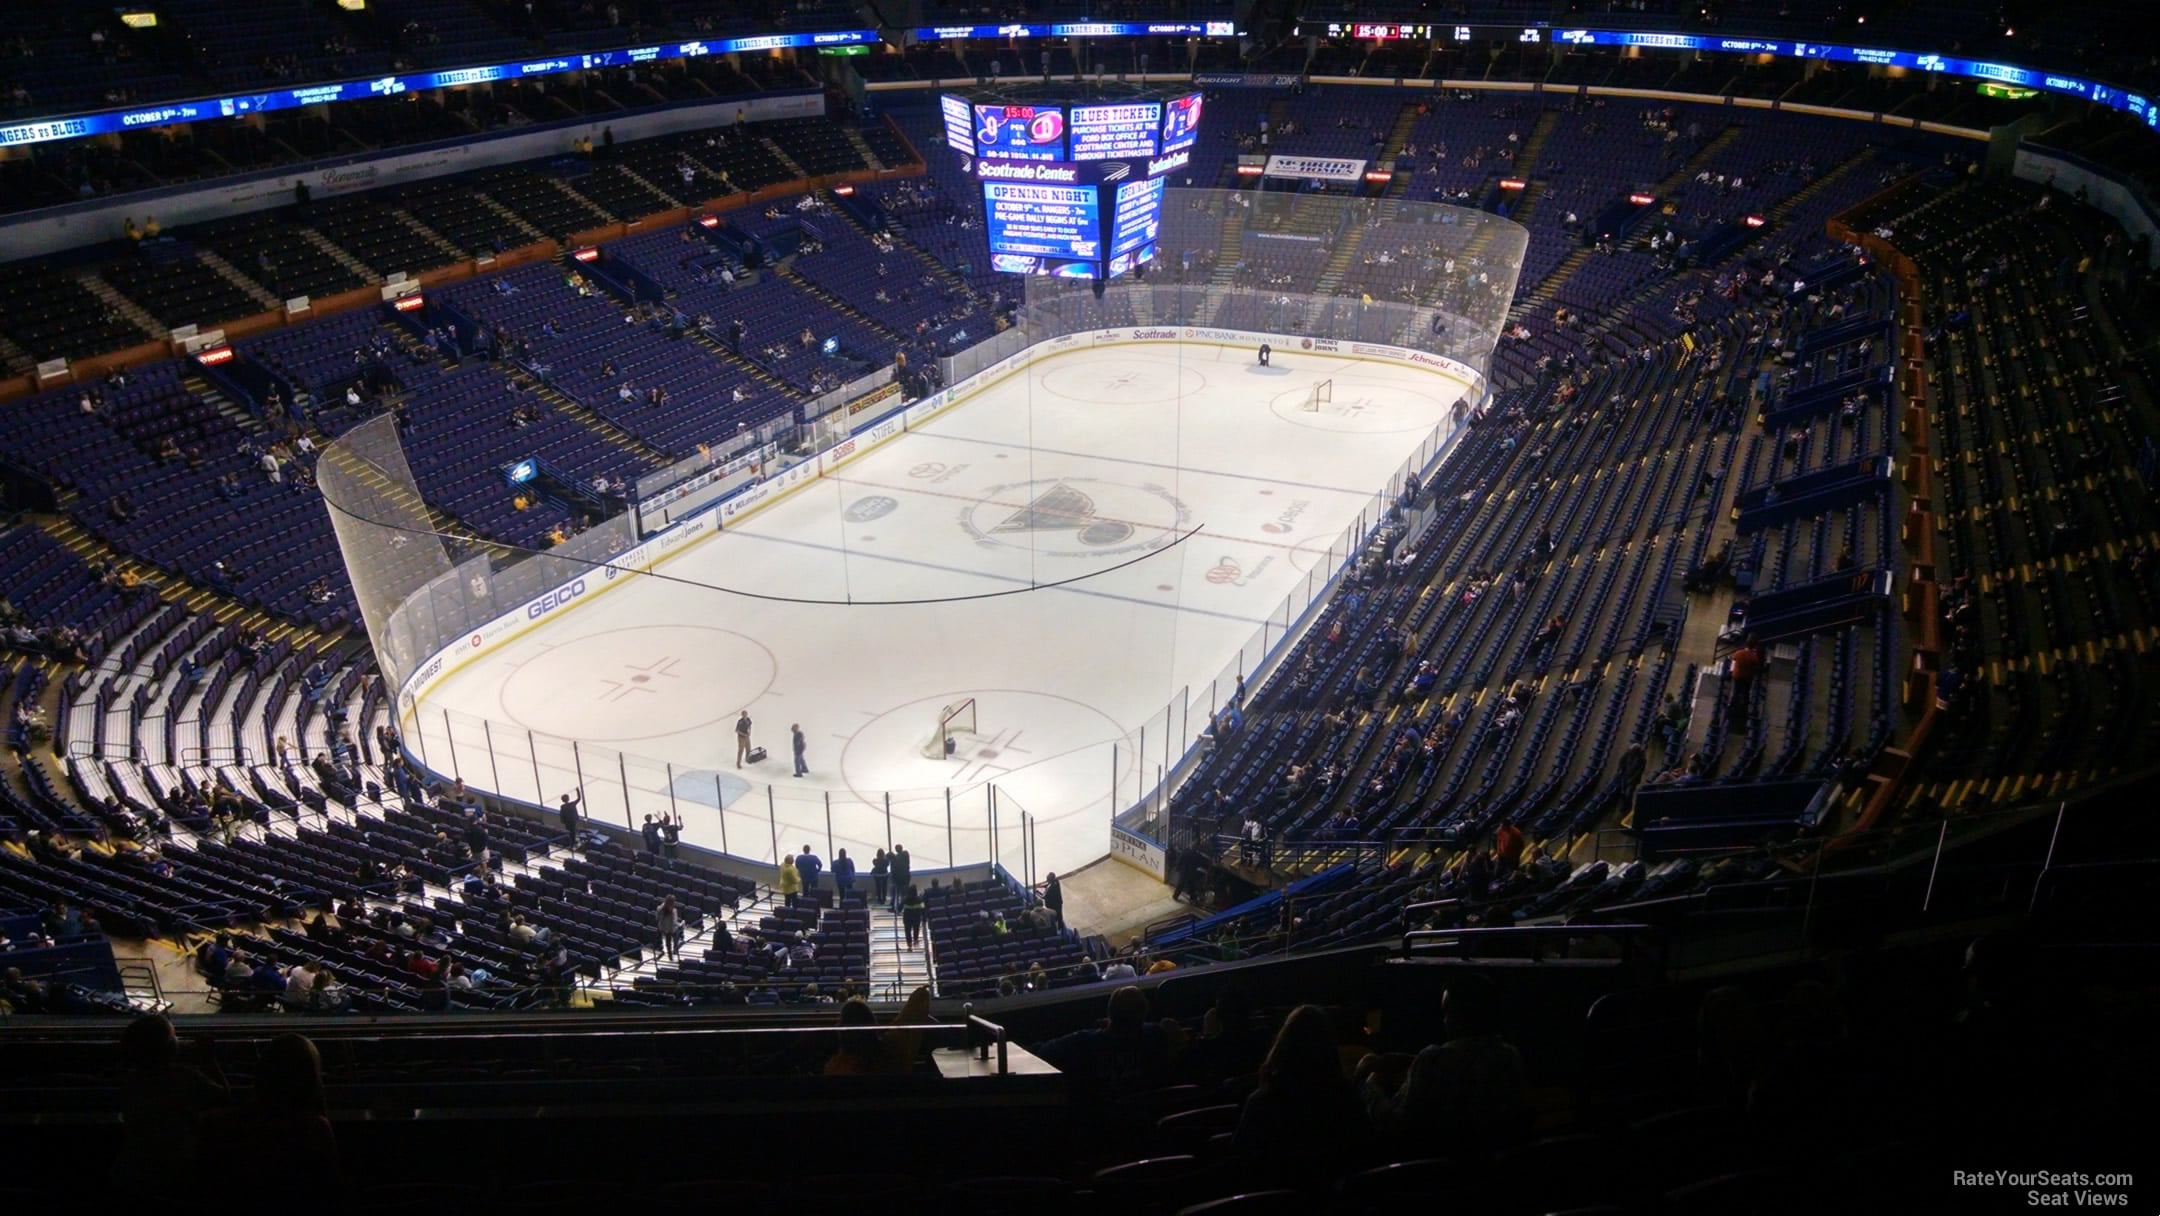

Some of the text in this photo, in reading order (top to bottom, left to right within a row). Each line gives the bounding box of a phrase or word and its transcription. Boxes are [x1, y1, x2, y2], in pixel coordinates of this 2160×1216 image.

[1358, 25, 1388, 37] 15:00
[123, 113, 162, 125] OCTOBER
[1006, 107, 1034, 118] 15:00
[1074, 106, 1157, 123] BLUES TICKETS
[51, 120, 87, 137] BLUES
[1072, 126, 1106, 134] PURCHASE
[1109, 123, 1134, 132] TICKETS
[1145, 122, 1158, 130] THE
[1101, 133, 1114, 141] BOX
[1115, 132, 1138, 140] OFFICE
[1139, 131, 1147, 139] AT
[1074, 142, 1112, 152] SCOTTRADE
[1113, 141, 1139, 149] CENTER
[1074, 149, 1153, 160] THROUGH TICKETMASTER
[978, 161, 1075, 181] Scottrade Center
[1148, 157, 1174, 176] Scottrade
[994, 187, 1089, 202] OPENING NIGHT
[995, 202, 1023, 211] OCTOBER
[1041, 205, 1071, 215] RANGERS
[995, 211, 1025, 221] PRE-GAME
[1026, 213, 1045, 222] RALLY
[1046, 215, 1067, 224] BEGINS
[1133, 329, 1177, 340] Scottrade
[1195, 331, 1237, 340] PNC BANK
[1239, 335, 1284, 345] MONSANTO
[1408, 353, 1451, 369] Schnucks
[871, 420, 897, 442] STIFEL
[684, 521, 704, 538] Jones
[527, 579, 586, 620] GEICO
[413, 658, 442, 690] MIDWEST
[1122, 842, 1160, 870] PLAN
